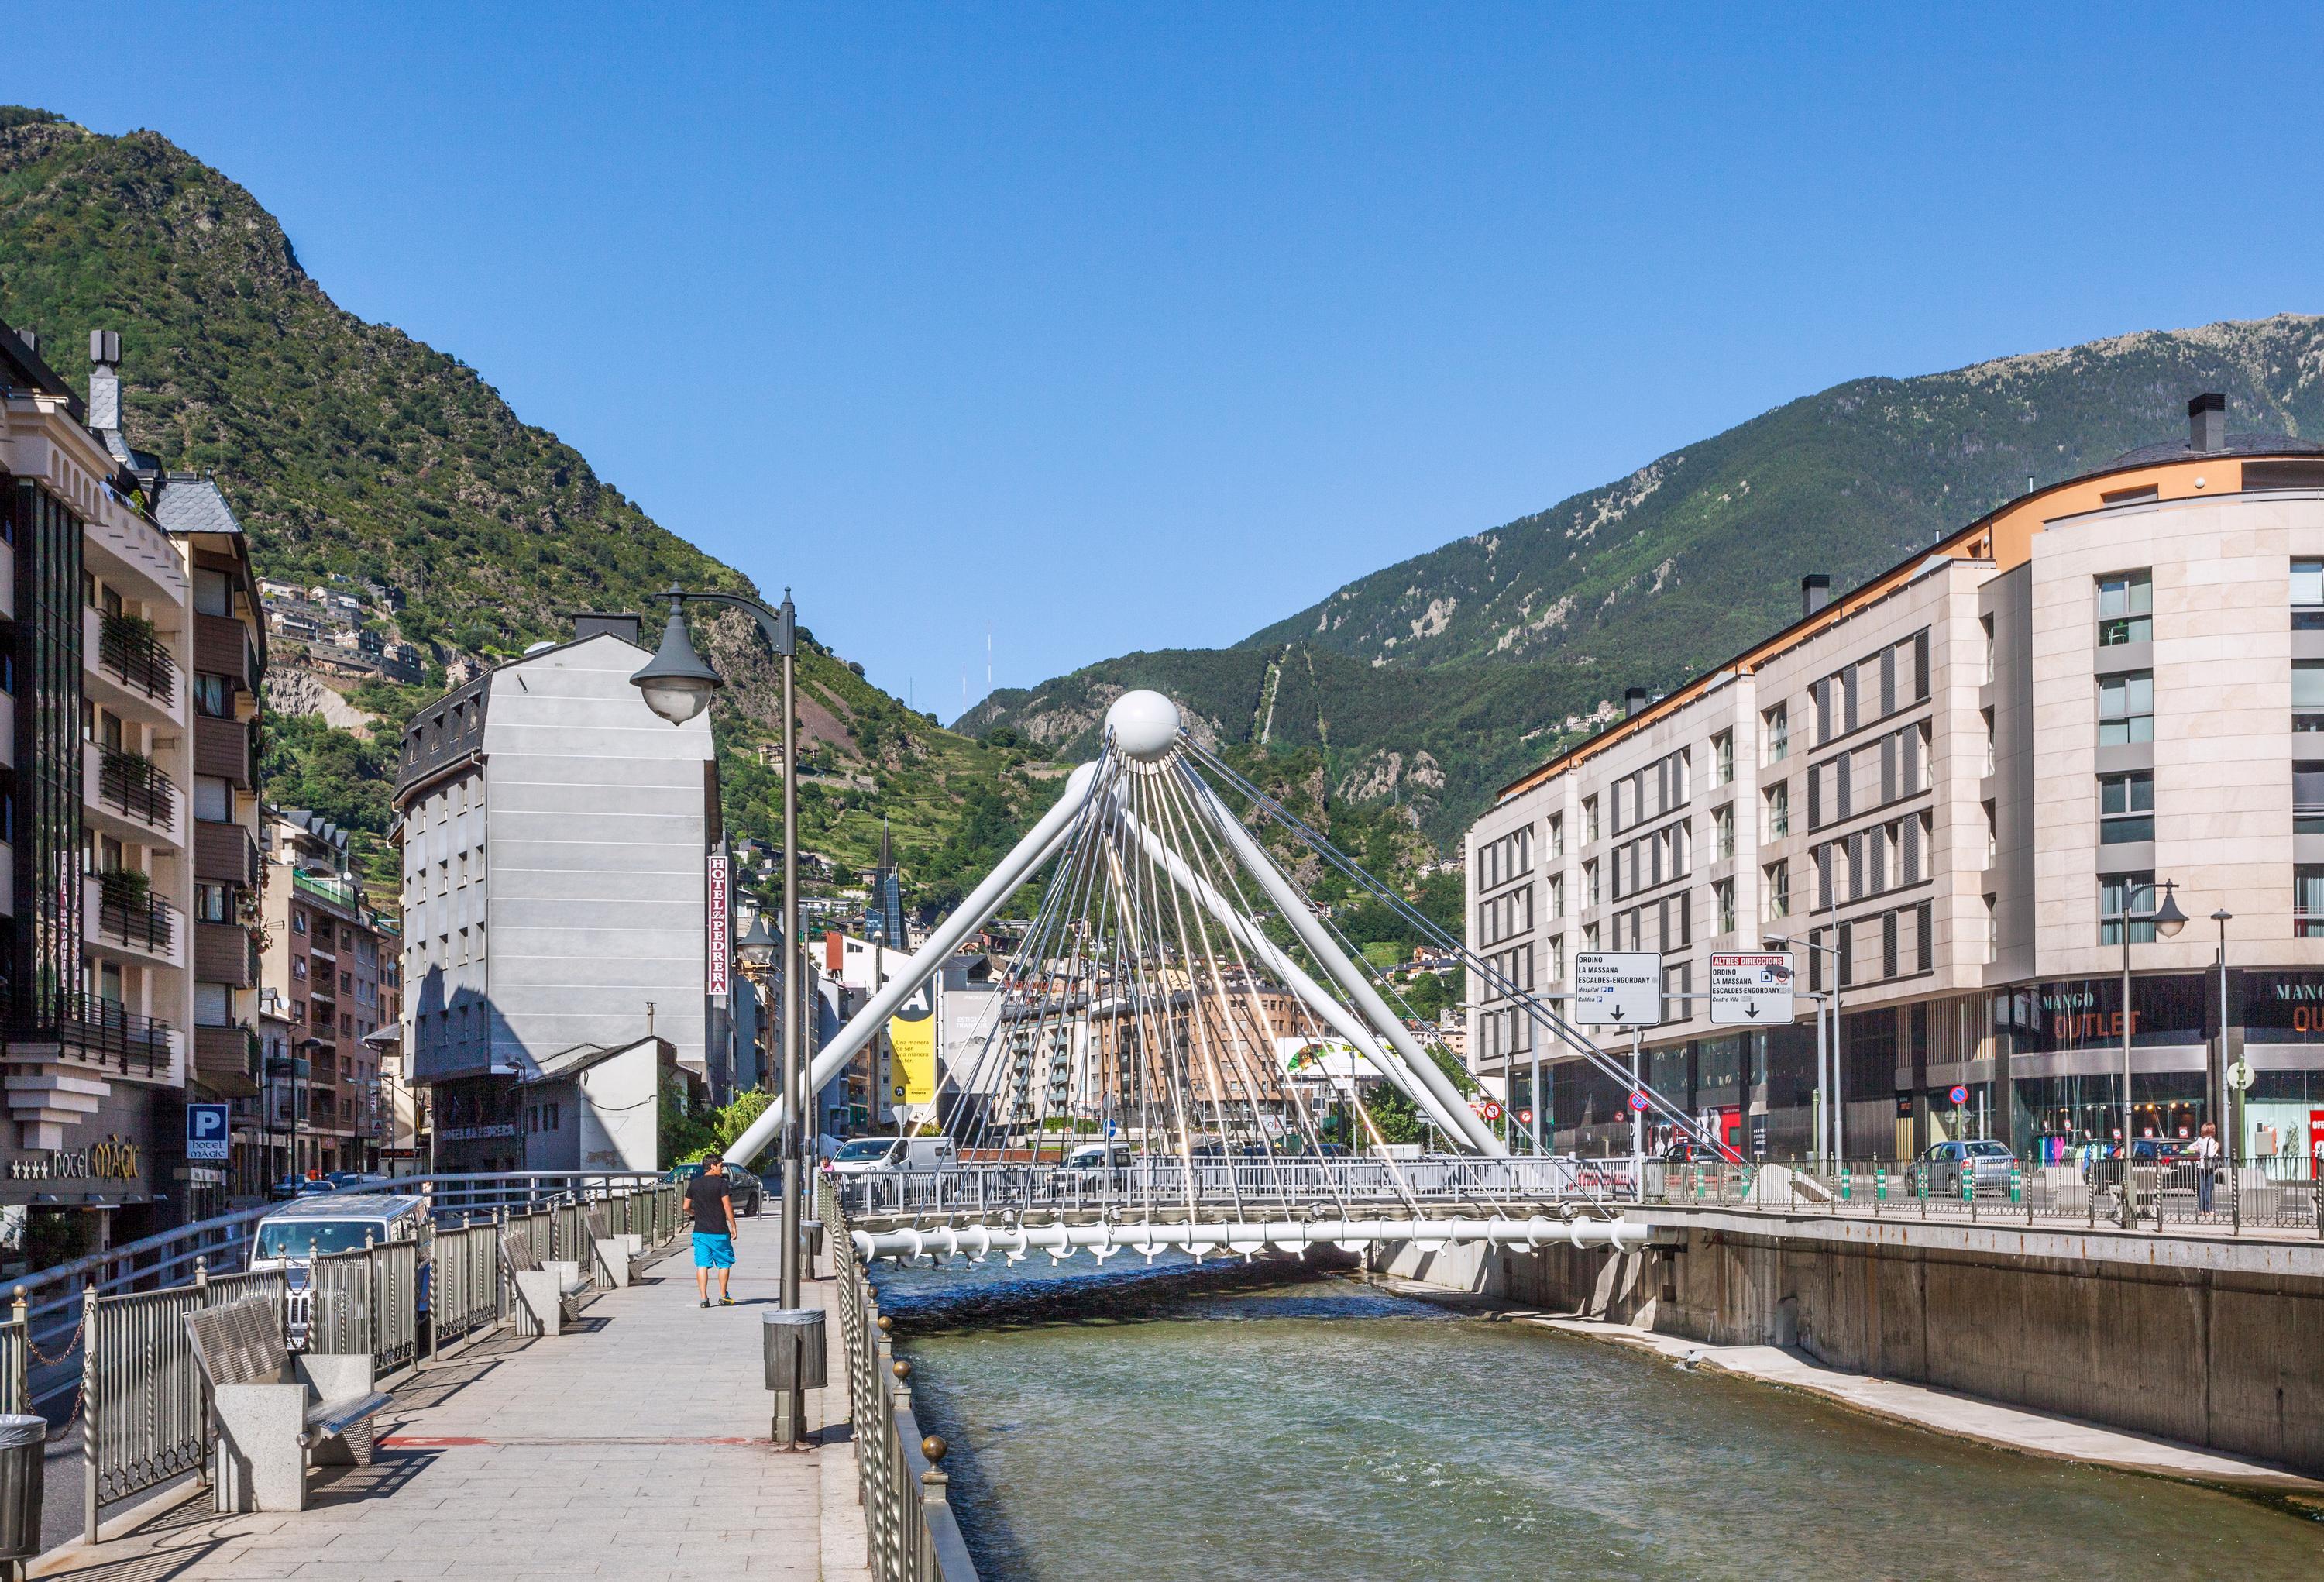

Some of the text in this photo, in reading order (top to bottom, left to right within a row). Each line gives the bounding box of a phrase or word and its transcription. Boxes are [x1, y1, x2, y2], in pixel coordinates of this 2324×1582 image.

[711, 858, 725, 992] HOTEL La PEDRERA
[2043, 992, 2093, 1010] MANGO
[2054, 1011, 2140, 1038] OUTLET
[196, 1111, 221, 1137] P
